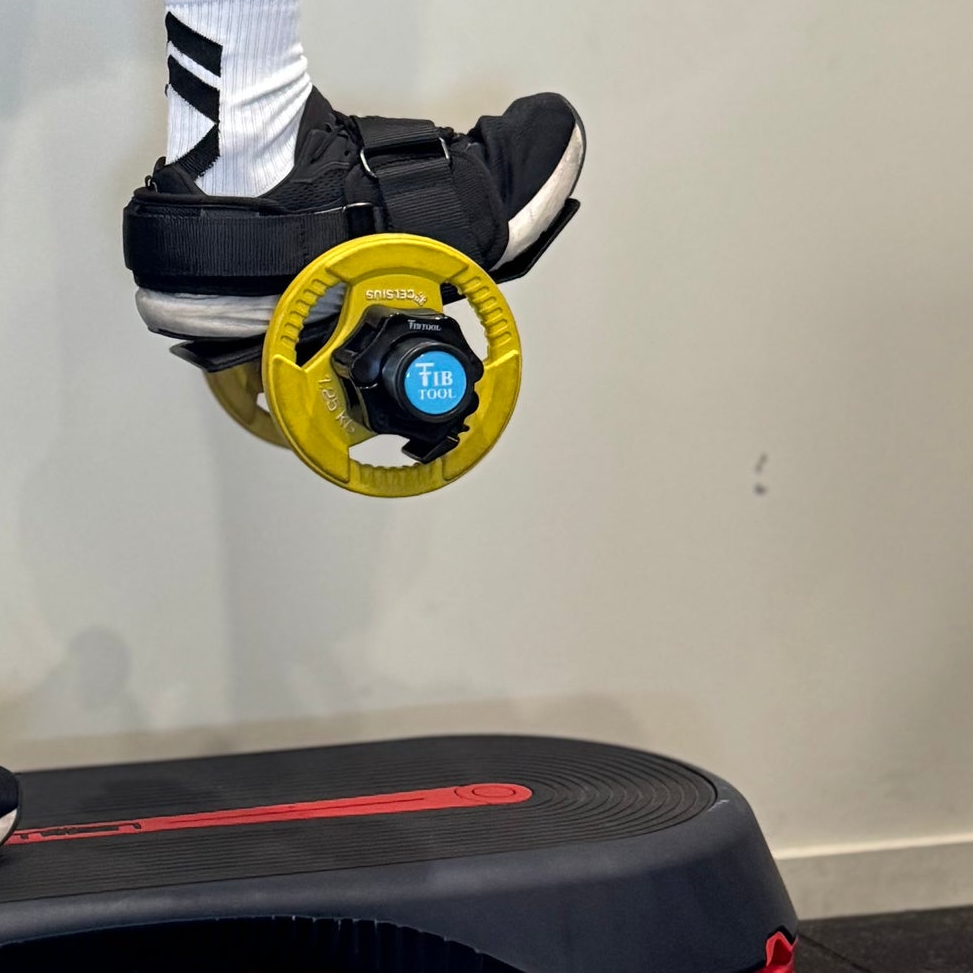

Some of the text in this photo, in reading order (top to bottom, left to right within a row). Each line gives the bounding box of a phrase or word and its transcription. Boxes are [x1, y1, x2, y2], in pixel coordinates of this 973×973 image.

[366, 289, 415, 300] CELSIUS
[415, 363, 454, 387] TIB
[419, 389, 457, 401] TOOL
